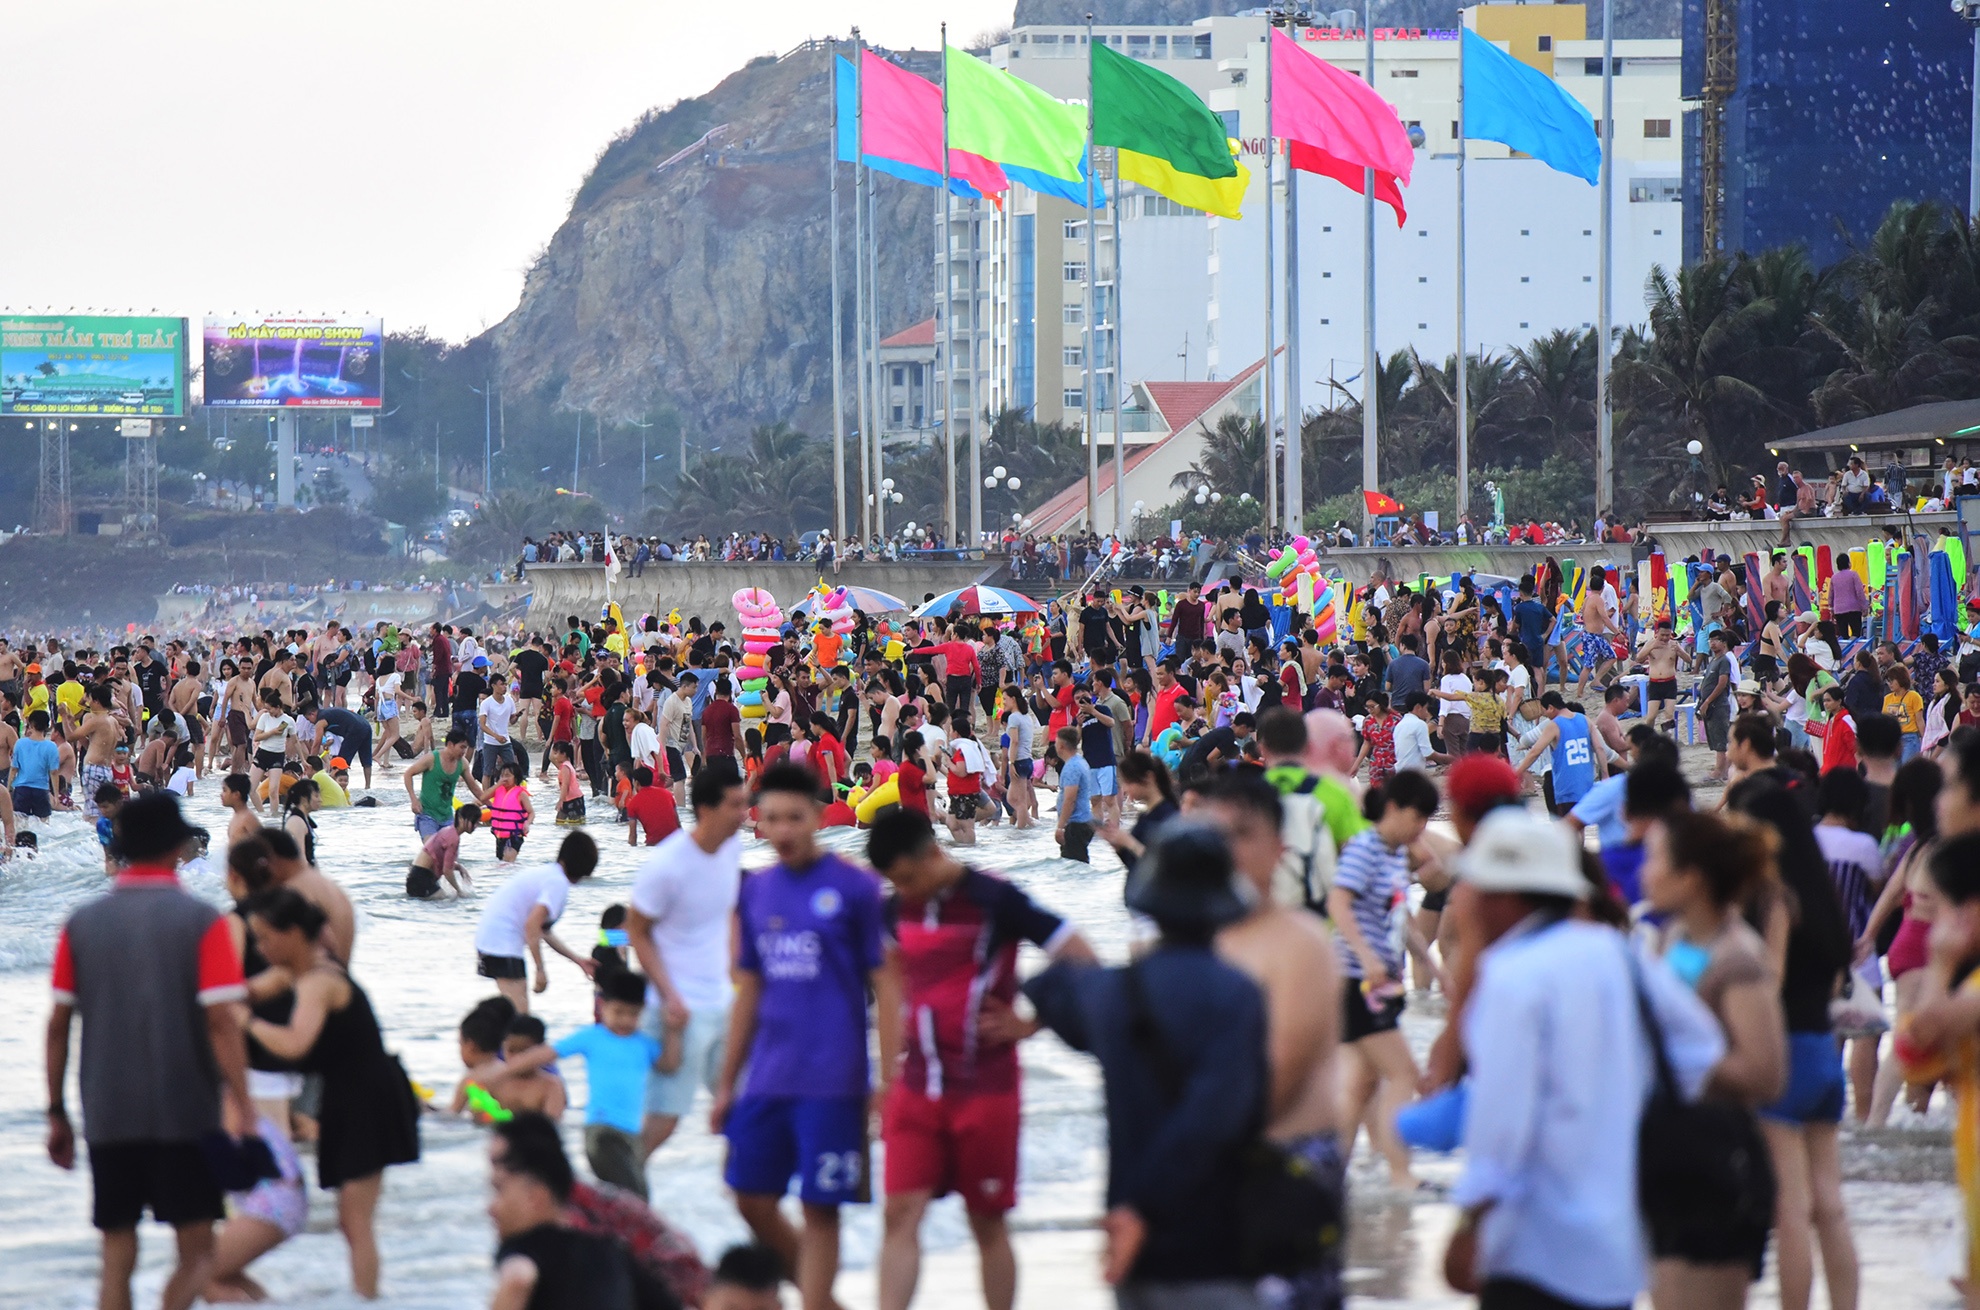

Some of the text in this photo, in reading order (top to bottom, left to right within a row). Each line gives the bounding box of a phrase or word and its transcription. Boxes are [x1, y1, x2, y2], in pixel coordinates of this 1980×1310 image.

[1304, 27, 1459, 41] OCEAN STAR Hot
[98, 329, 133, 348] TRÍ
[248, 324, 277, 340] MÂY
[277, 326, 324, 340] GRAND
[323, 326, 364, 340] SHOW
[1564, 737, 1590, 766] 25
